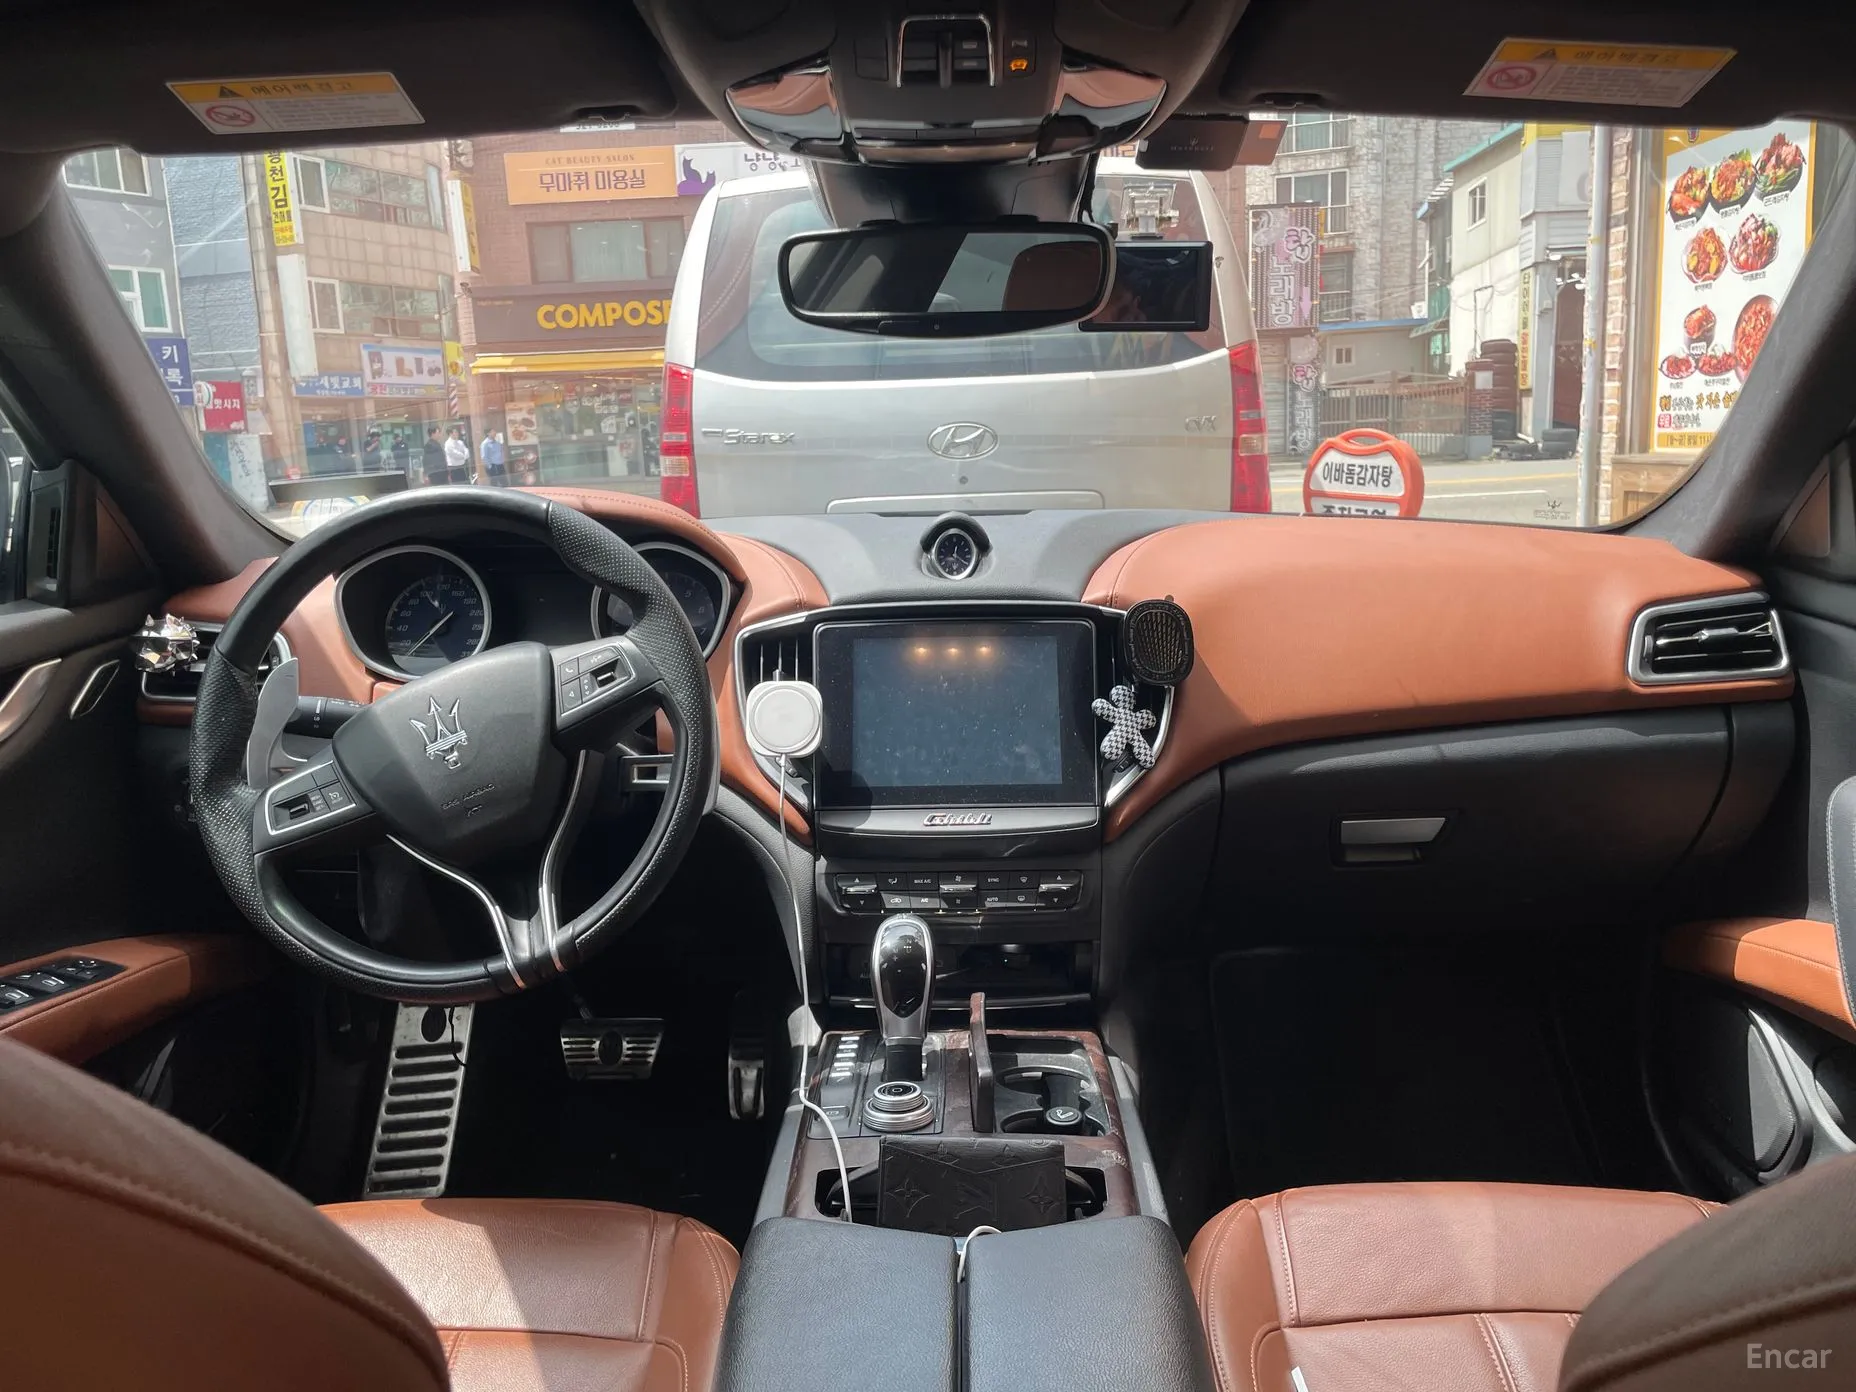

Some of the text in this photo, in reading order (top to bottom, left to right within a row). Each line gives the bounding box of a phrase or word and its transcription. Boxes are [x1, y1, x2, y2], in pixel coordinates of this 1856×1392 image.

[539, 169, 646, 193] 무마취 미용실
[1270, 256, 1297, 326] 노래방
[1322, 461, 1393, 488] 이바돔감자탕
